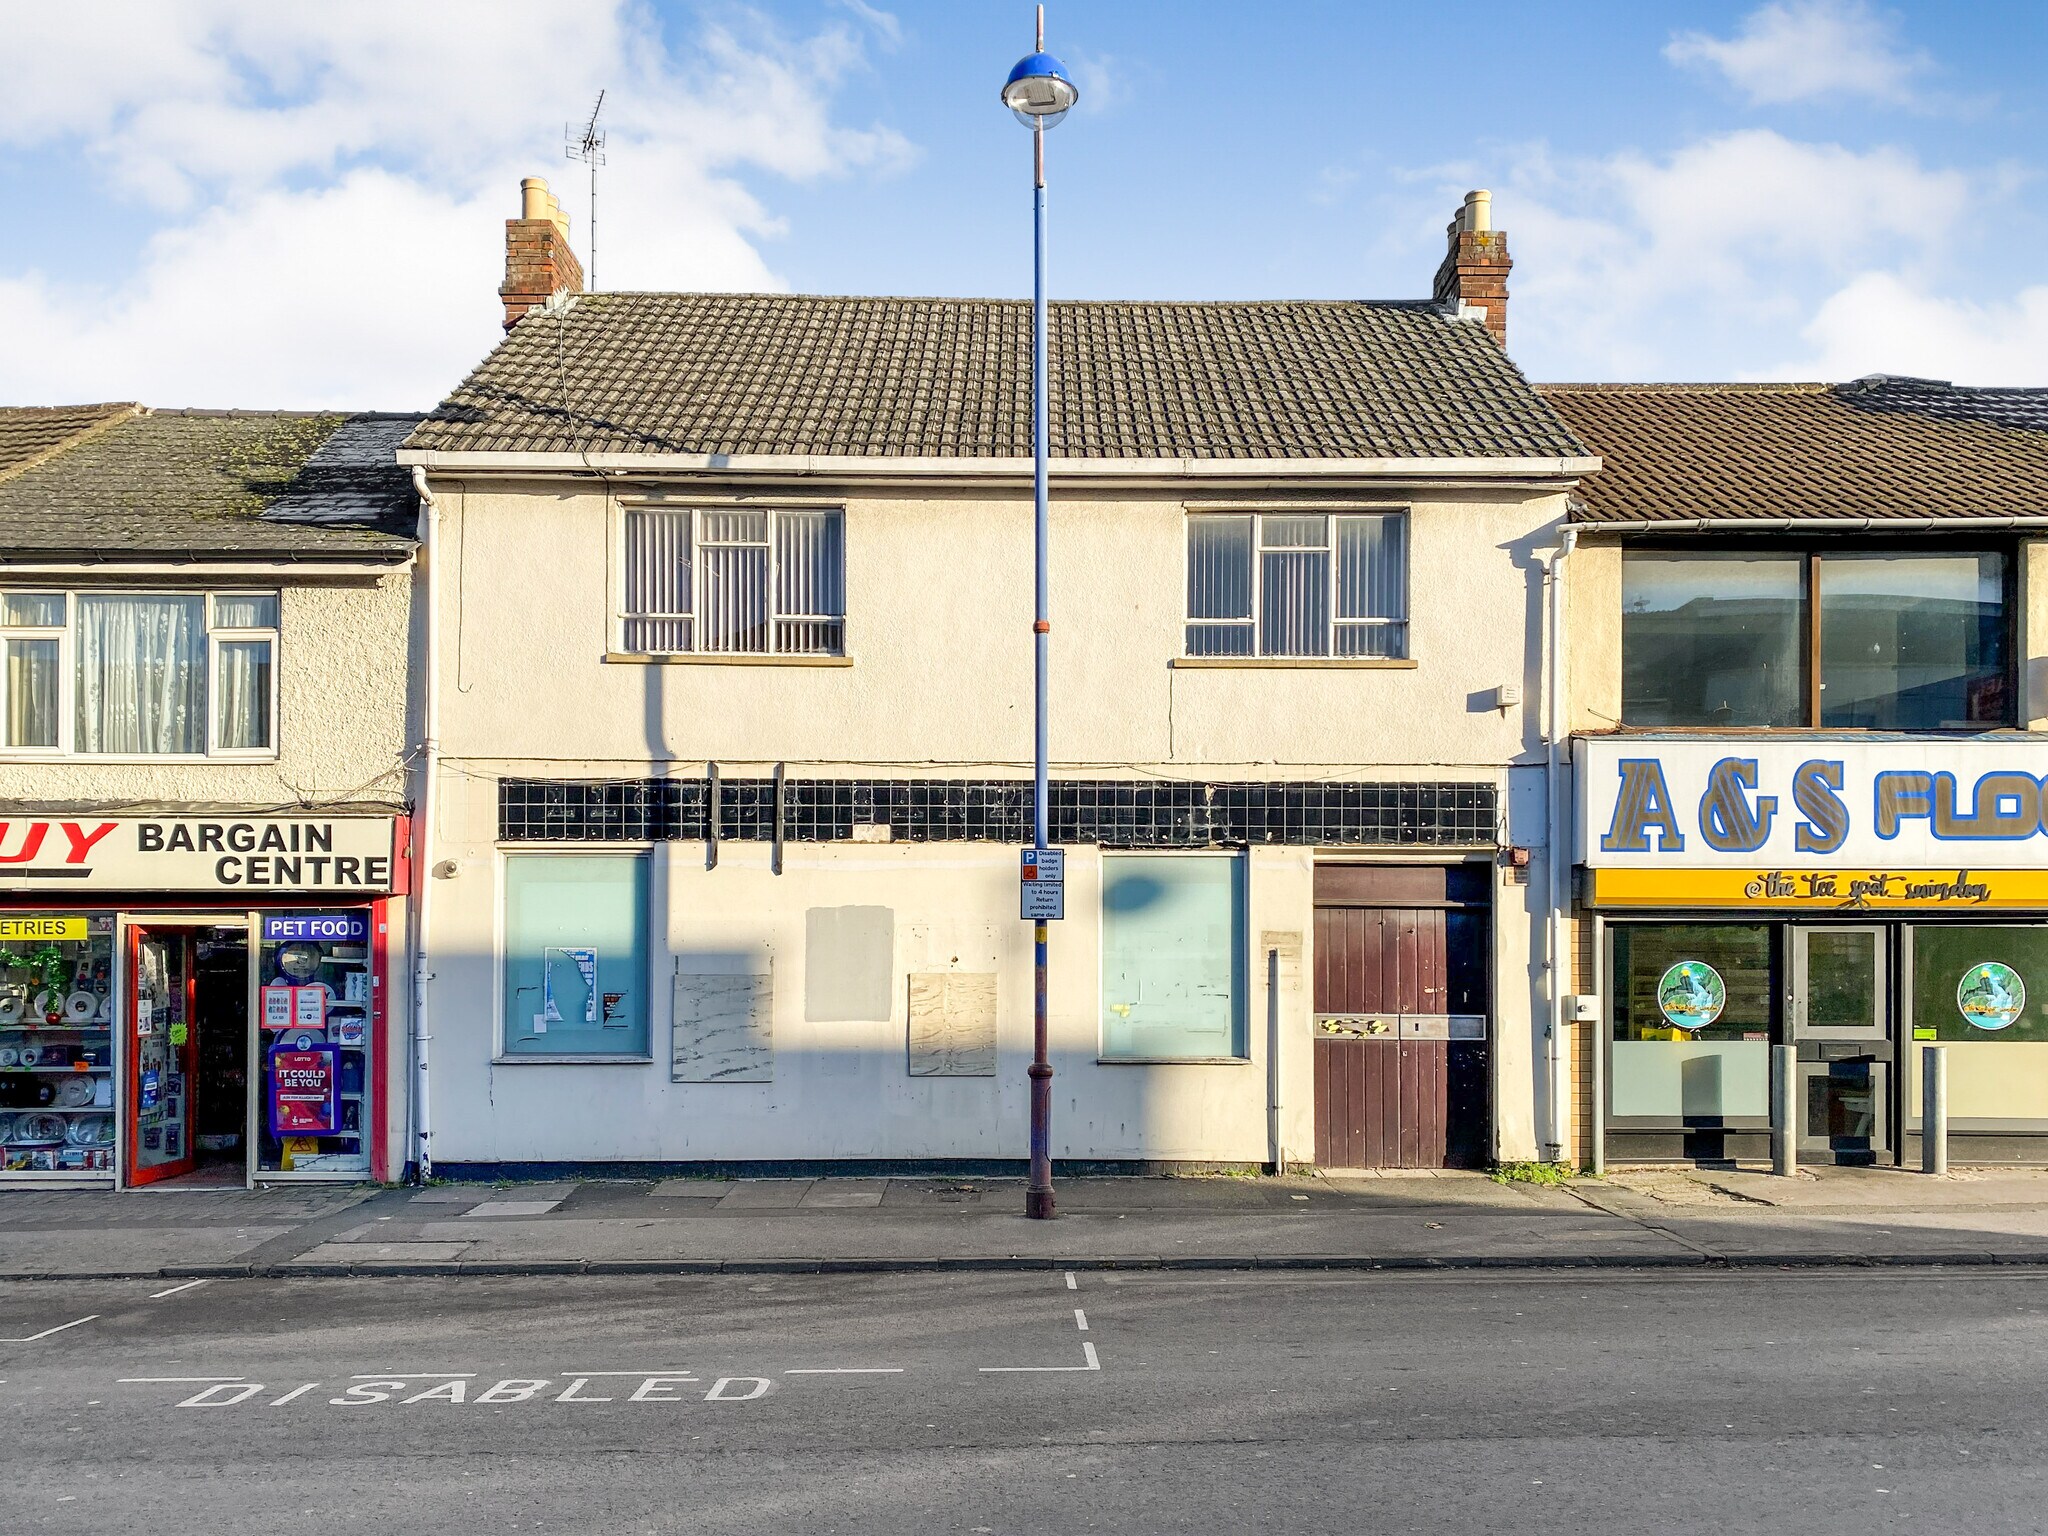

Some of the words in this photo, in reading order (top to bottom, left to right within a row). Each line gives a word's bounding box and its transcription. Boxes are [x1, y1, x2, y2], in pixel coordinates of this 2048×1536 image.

[1873, 769, 2048, 841] FLO
[138, 824, 333, 852] BARGAIN
[1026, 852, 1035, 863] P
[215, 856, 389, 885] CENTRE
[271, 920, 306, 936] PET
[310, 920, 363, 936] FOOD
[278, 1069, 289, 1078] IT
[290, 1069, 326, 1078] COULD
[284, 1078, 298, 1087] BE
[299, 1078, 321, 1087] YOU
[175, 1376, 772, 1408] DISABLED
